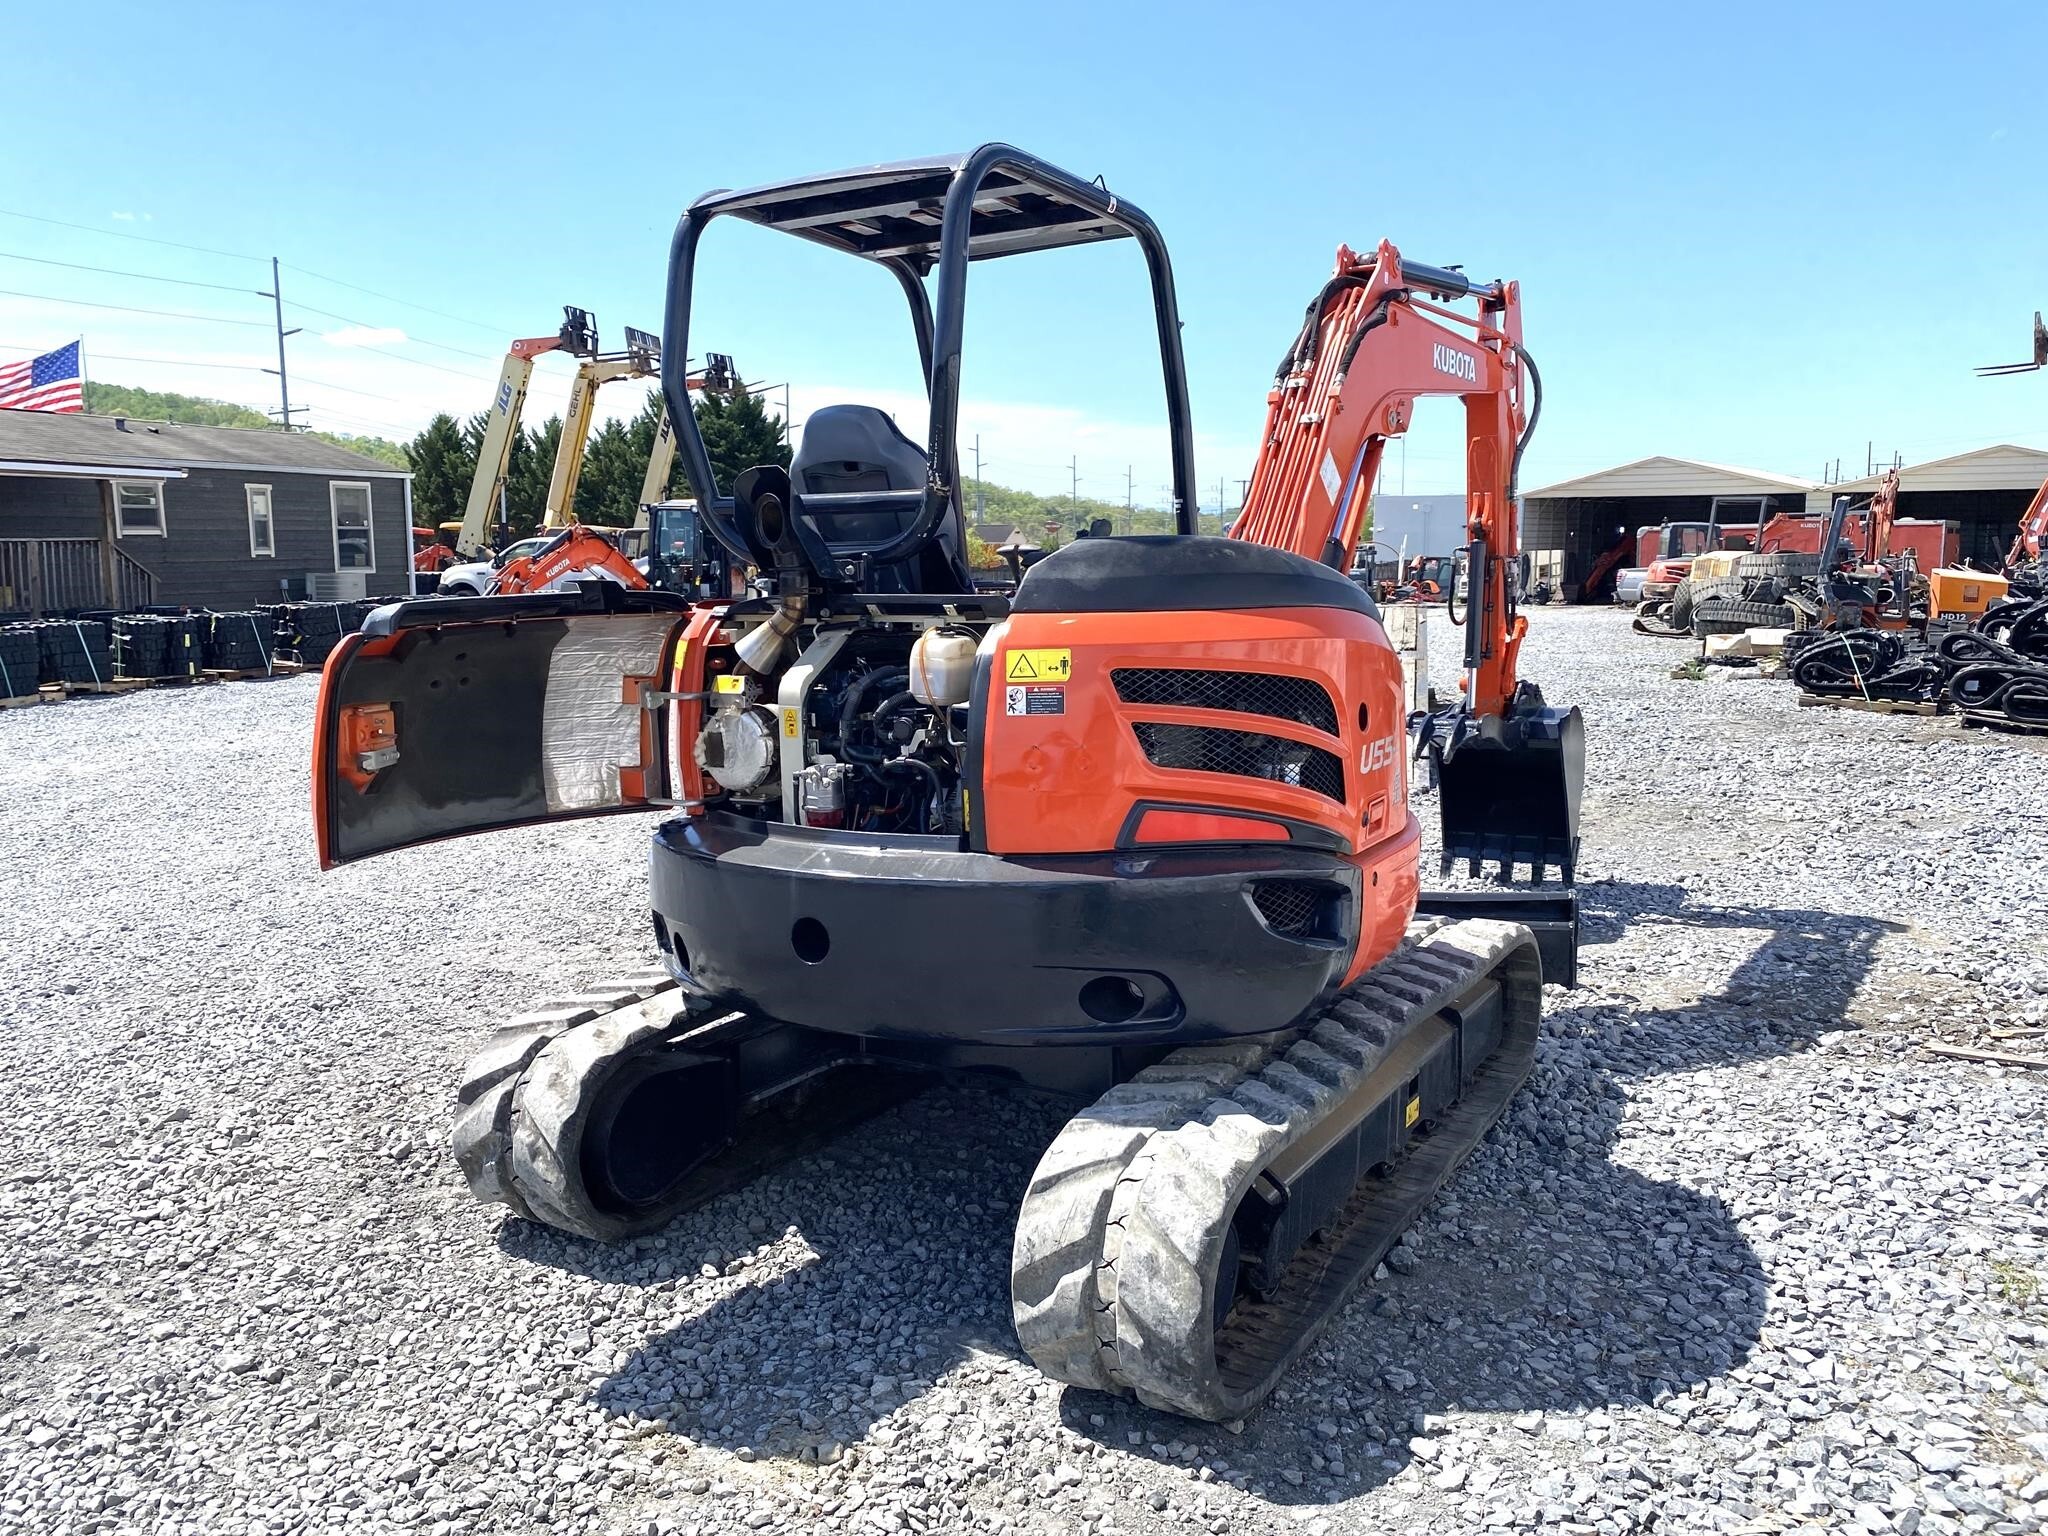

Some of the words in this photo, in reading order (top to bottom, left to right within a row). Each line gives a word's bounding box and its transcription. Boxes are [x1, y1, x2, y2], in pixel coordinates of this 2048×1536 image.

[1433, 343, 1476, 382] KUBOTA
[498, 382, 512, 417] JLG
[569, 386, 582, 418] GEHL
[545, 558, 570, 579] KUBOTA
[1940, 613, 1967, 621] HD12
